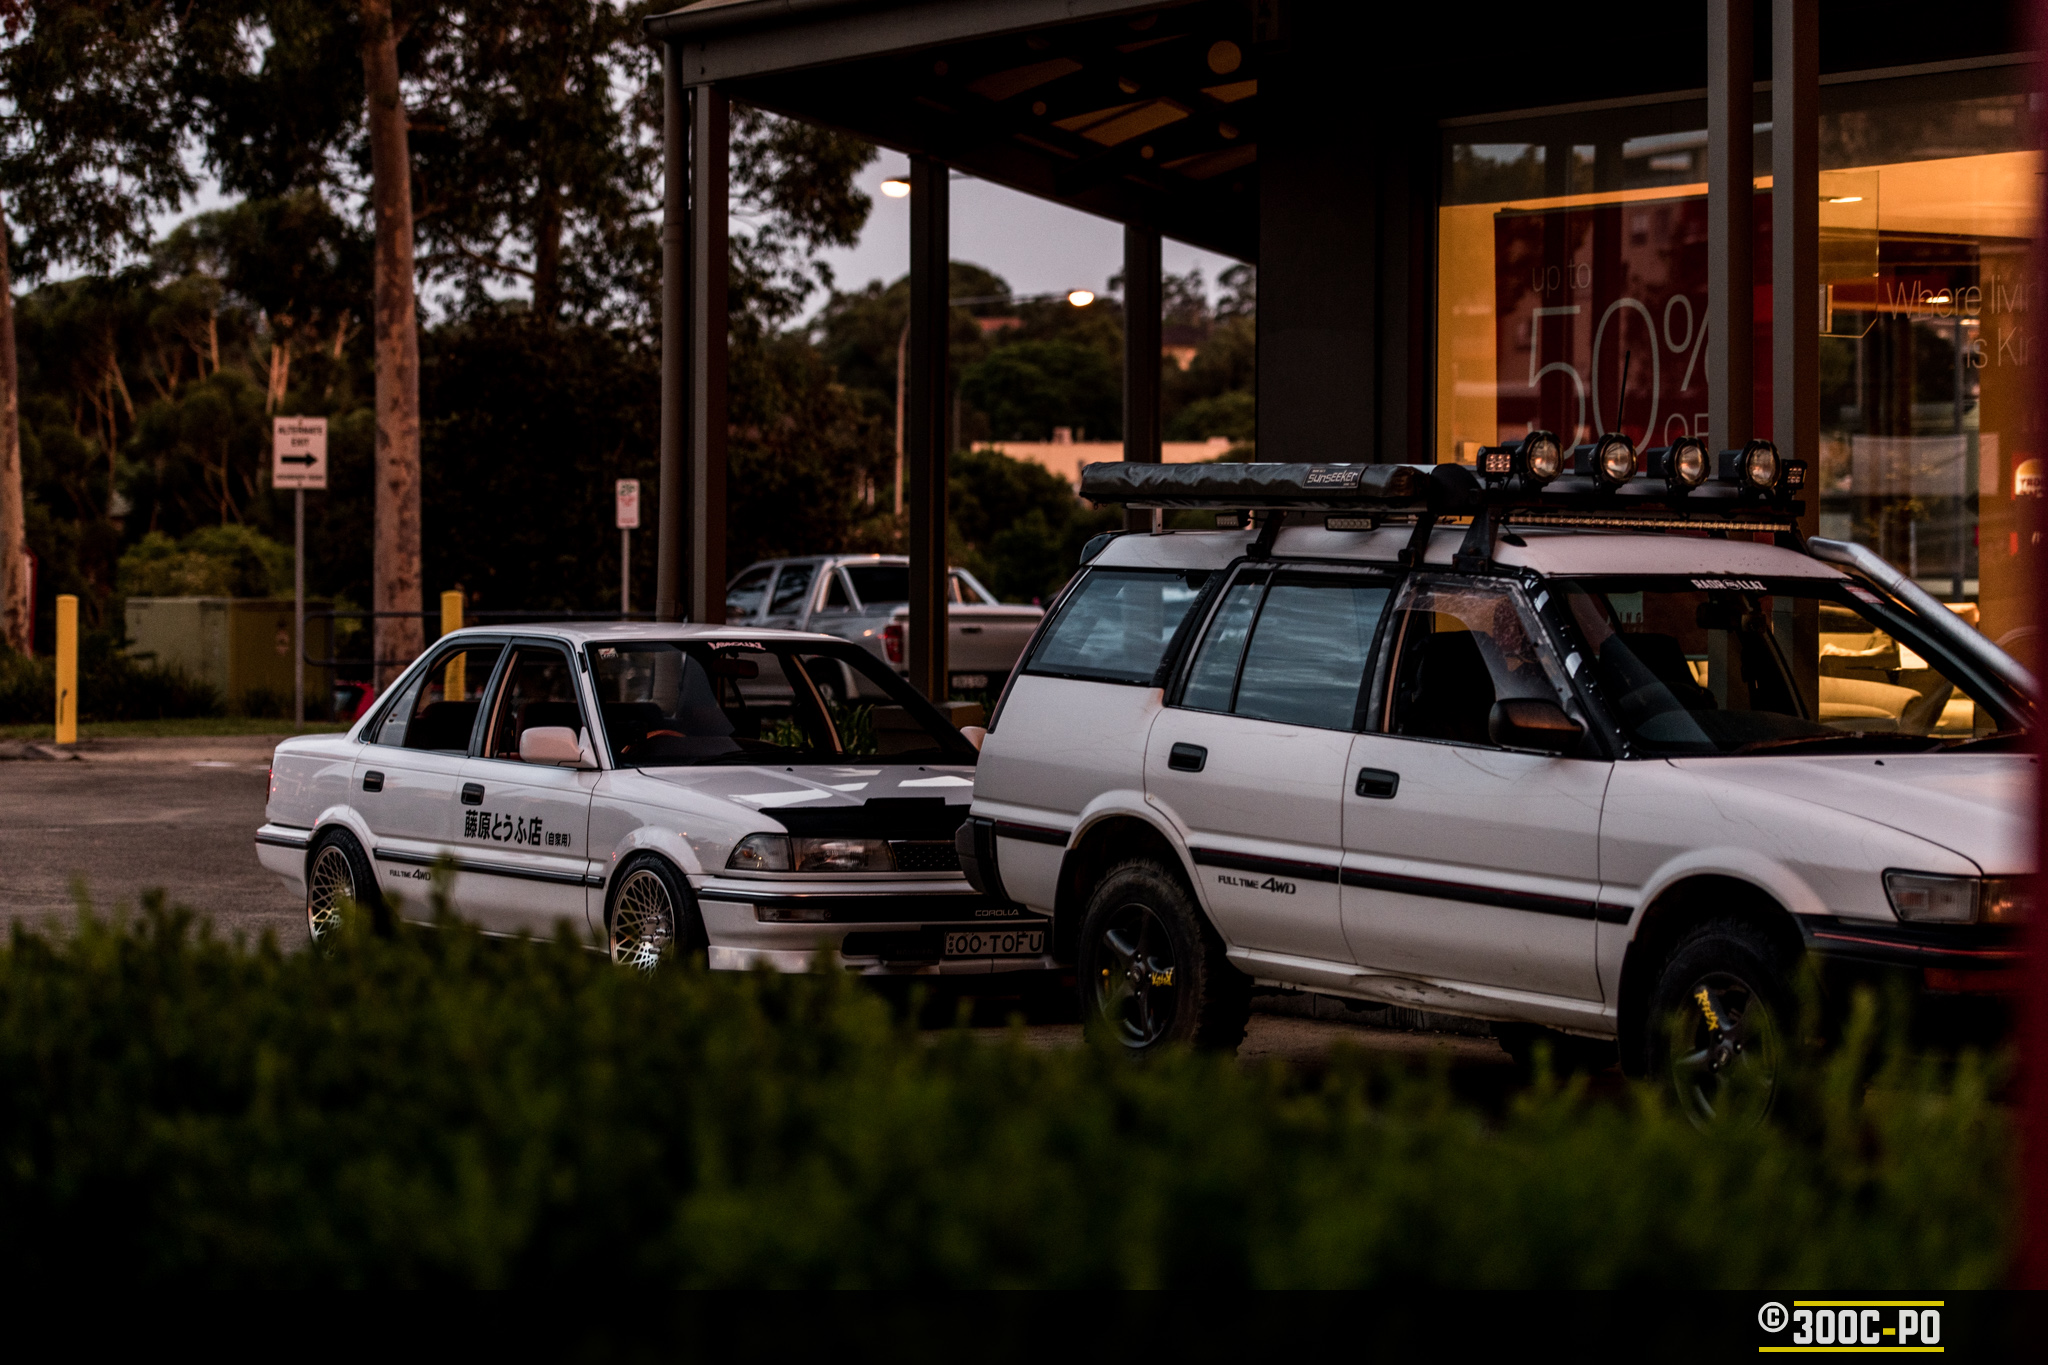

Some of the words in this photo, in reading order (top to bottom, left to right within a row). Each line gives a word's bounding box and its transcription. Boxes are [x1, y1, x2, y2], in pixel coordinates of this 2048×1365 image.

[1532, 264, 1561, 298] up
[1567, 258, 1592, 290] to
[1886, 279, 1982, 321] Where
[1966, 337, 1989, 369] is
[464, 809, 543, 846] 藤原とうふ店
[412, 868, 431, 881] 4WD
[1218, 874, 1239, 886] FULL
[1239, 878, 1259, 889] TIME
[1260, 877, 1297, 895] 4WD
[974, 908, 1020, 917] COROLLA
